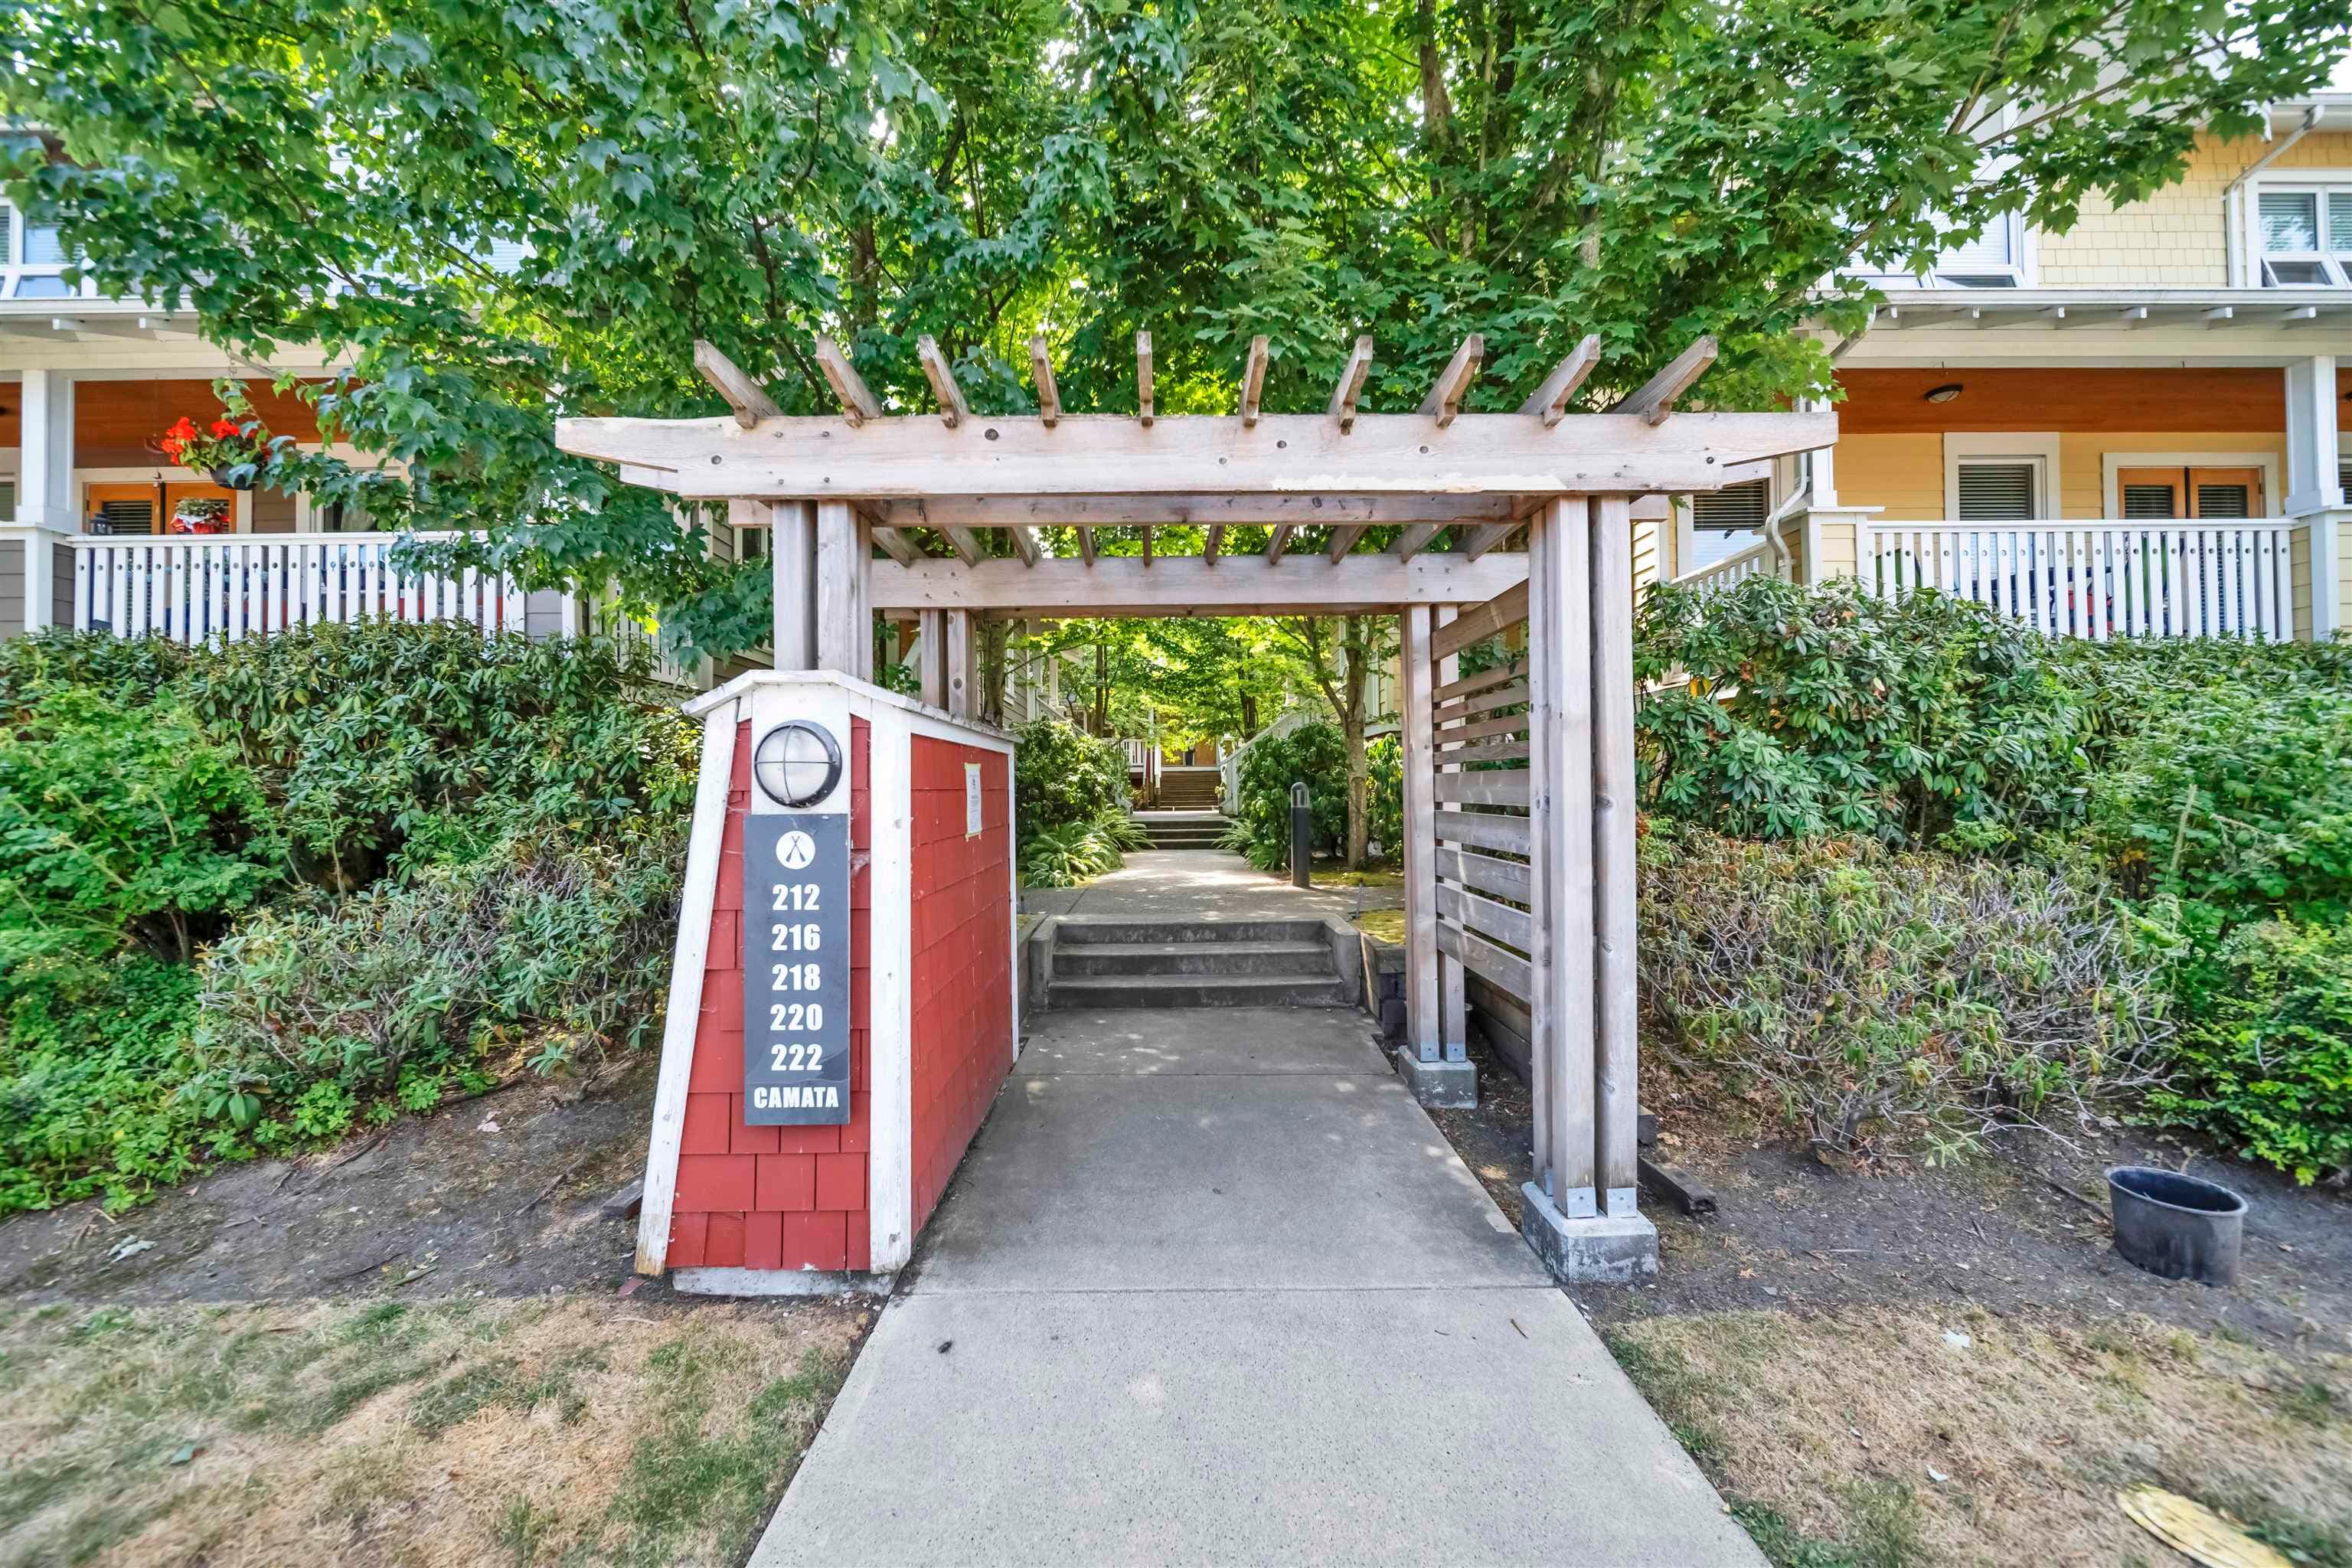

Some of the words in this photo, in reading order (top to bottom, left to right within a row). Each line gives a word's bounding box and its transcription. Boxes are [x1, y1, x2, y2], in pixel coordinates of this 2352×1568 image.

[772, 884, 820, 911] 212
[771, 923, 821, 951] 216
[772, 963, 821, 991] 218
[769, 1004, 823, 1031] 220
[771, 1044, 822, 1071] 222
[753, 1086, 839, 1109] CAMATA
